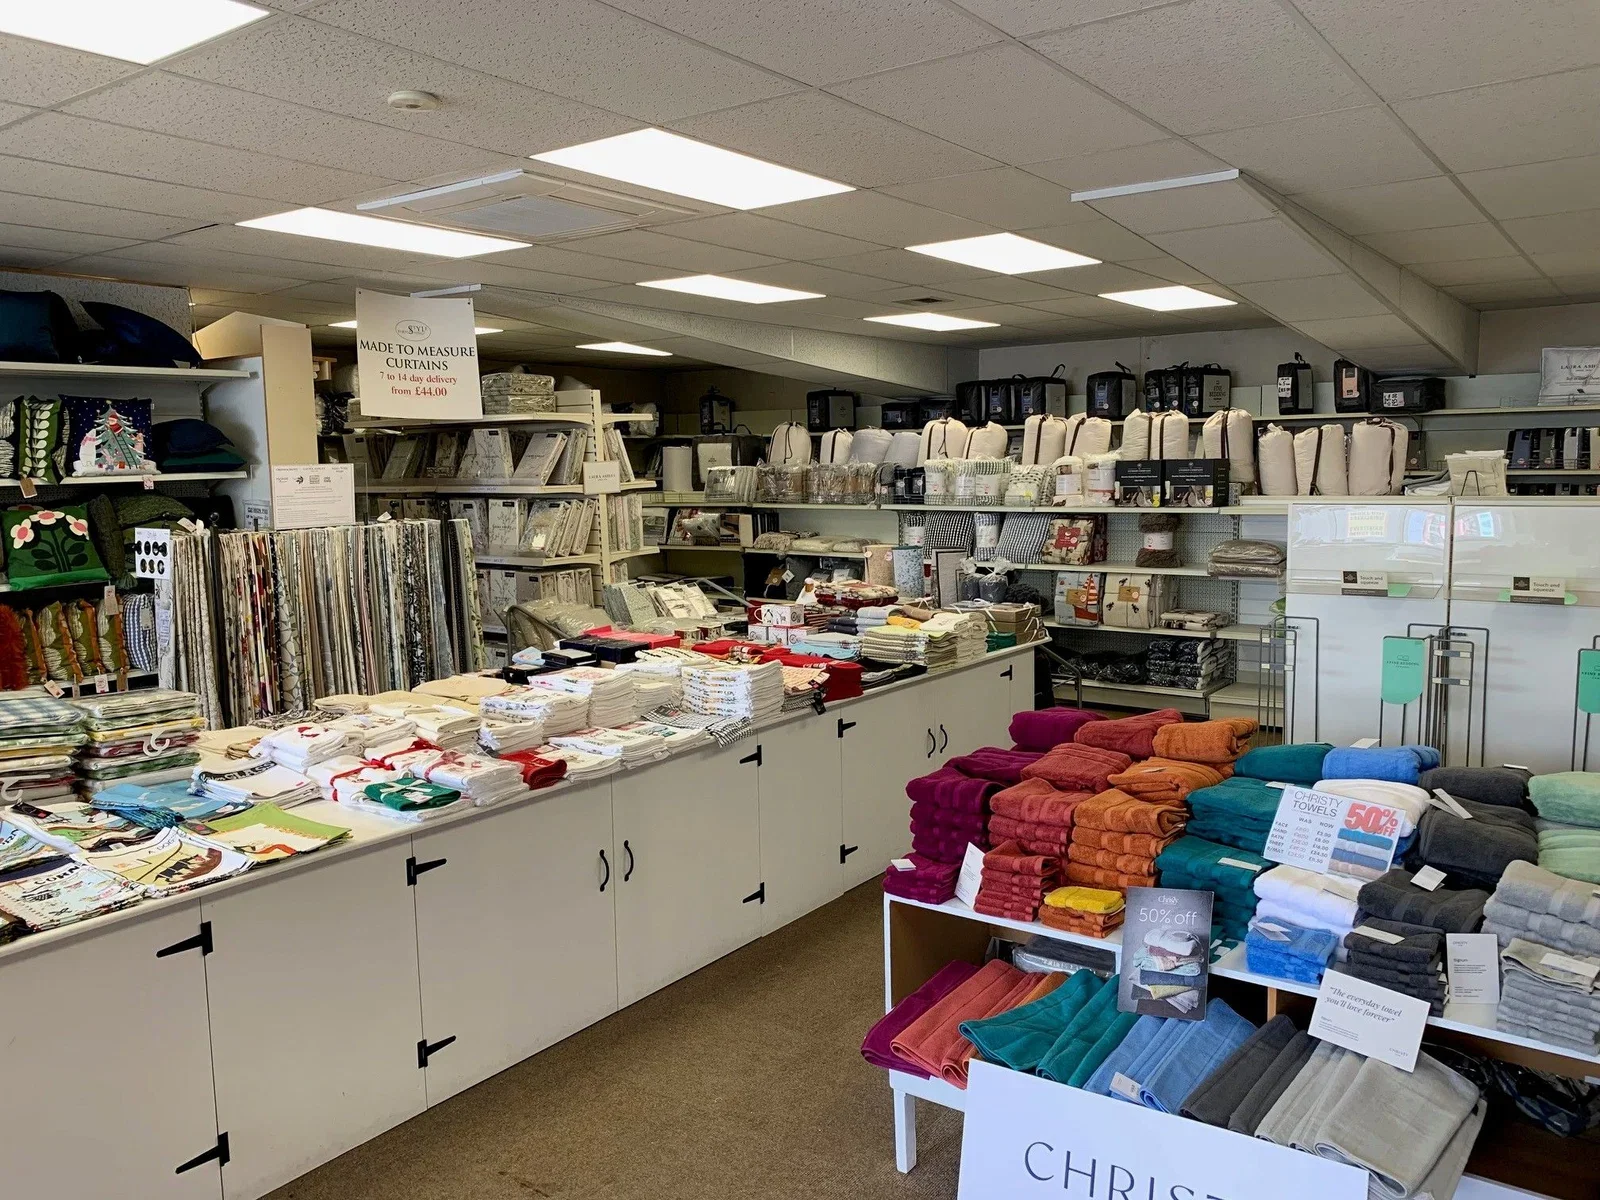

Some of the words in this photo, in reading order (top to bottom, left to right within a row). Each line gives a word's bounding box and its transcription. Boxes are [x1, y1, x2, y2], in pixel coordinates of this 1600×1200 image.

[360, 340, 394, 354] MADE
[396, 344, 414, 355] TO
[417, 346, 476, 357] MEASURE
[386, 357, 449, 371] CURTAINS
[379, 371, 384, 379] 7
[387, 373, 395, 381] to
[398, 373, 407, 381] 14
[409, 374, 424, 385] day
[426, 374, 458, 385] delivery
[391, 386, 411, 396] from
[415, 386, 448, 397] £44.00
[1294, 790, 1343, 808] CHRISTY
[1293, 800, 1338, 818] TOWELS
[1344, 802, 1399, 833] 50%
[1139, 907, 1172, 924] 50%
[1174, 911, 1198, 926] off
[1324, 996, 1346, 1008] you'll
[1346, 1002, 1362, 1014] love
[1363, 1008, 1395, 1023] forever"
[1346, 993, 1381, 1010] everyday
[1381, 1004, 1403, 1017] towel
[1024, 1141, 1224, 1200] CHRI
